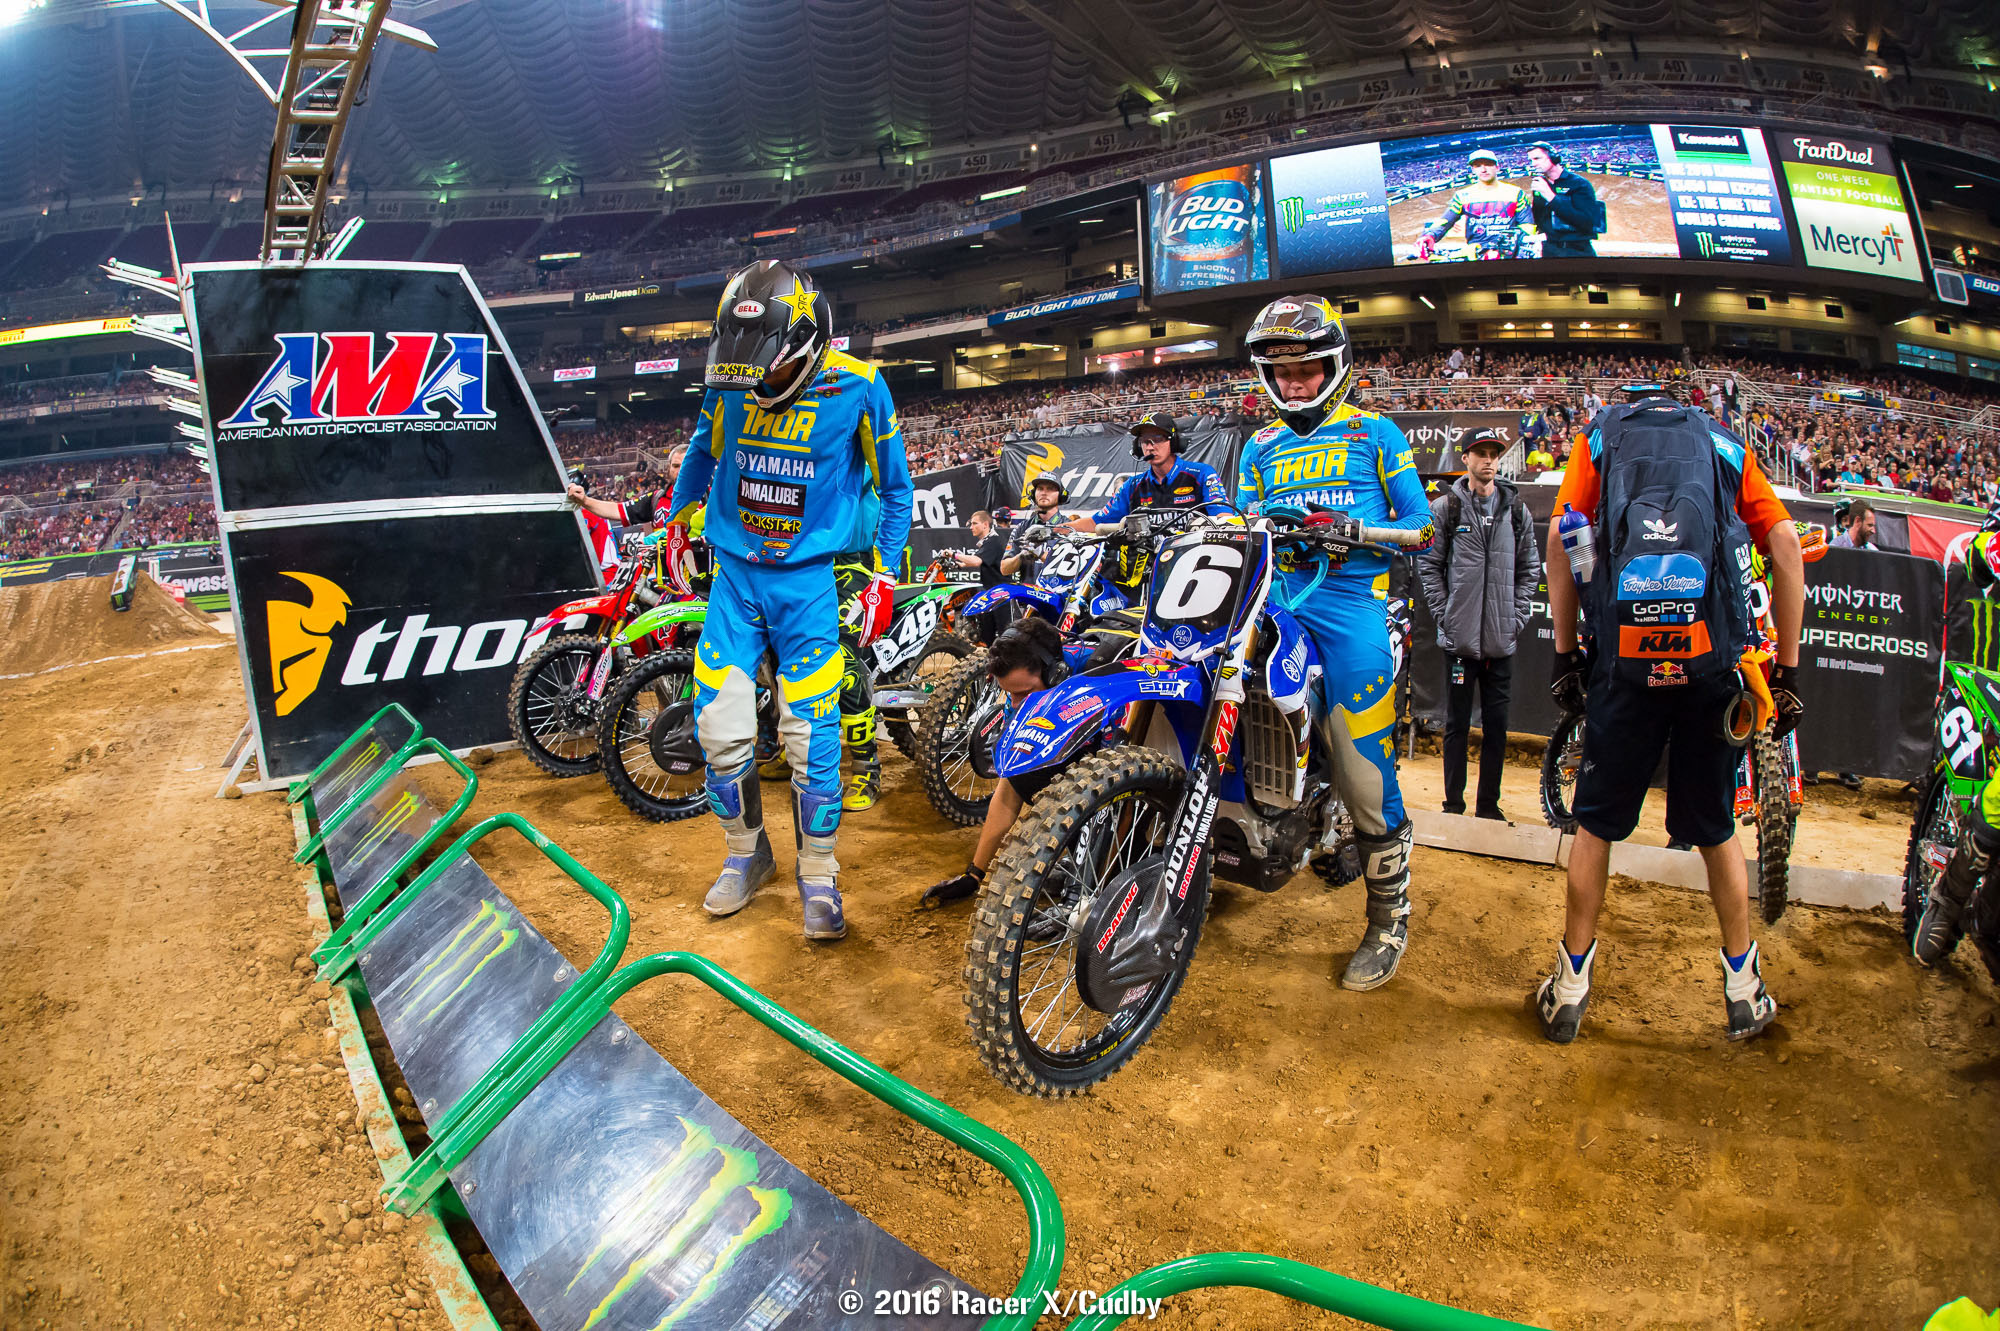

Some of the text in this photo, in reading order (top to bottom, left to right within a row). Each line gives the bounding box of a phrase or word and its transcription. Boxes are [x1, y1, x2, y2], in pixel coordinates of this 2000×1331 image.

[1512, 62, 1540, 77] 454
[1663, 60, 1688, 73] 401
[1363, 79, 1389, 93] 453
[1224, 106, 1249, 121] 452
[963, 154, 988, 169] 450
[1792, 137, 1874, 166] FanDuel
[1816, 170, 1872, 188] ONE-WEEK
[1178, 195, 1245, 216] BUD
[1793, 183, 1901, 207] FANTASY FOOTBALL
[1305, 204, 1387, 222] SUPERCROSS
[1165, 214, 1250, 238] LIGHT
[1810, 224, 1886, 265] Mercy
[1973, 278, 2000, 292] BUD
[737, 305, 759, 314] BELL
[1004, 290, 1119, 321] BUD LIGHT PARTY ZONE
[217, 331, 497, 430] AMA
[217, 420, 497, 442] AMERICAN MOTORCYCLIST ASSOCIATION
[743, 403, 817, 442] THOR
[748, 453, 815, 479] YAMAHA
[1270, 449, 1349, 486] THOR
[741, 479, 800, 506] YAMALUBE
[1284, 489, 1356, 507] YAMAHA
[1322, 543, 1349, 553] ARC
[1642, 533, 1679, 542] adidas
[1042, 542, 1098, 577] 23
[1156, 544, 1244, 620] 6
[1623, 575, 1704, 594] Troy Lee Designs
[1632, 601, 1696, 615] GoPro
[1803, 583, 1904, 613] MONSTER
[898, 600, 938, 647] 48
[1818, 610, 1891, 625] ENERGY
[901, 639, 927, 659] Kawasaki
[1638, 630, 1693, 652] KTM
[1816, 657, 1885, 676] FIM World Championship
[1140, 680, 1183, 693] star
[1647, 675, 1689, 687] Red Bull
[1067, 696, 1090, 707] TOYOTA
[1940, 706, 1984, 771] 61
[1194, 793, 1219, 844] YAMALUBE
[1166, 770, 1209, 894] DUNLOP
[1178, 845, 1201, 901] BRAKING
[1097, 881, 1139, 954] BRAKING
